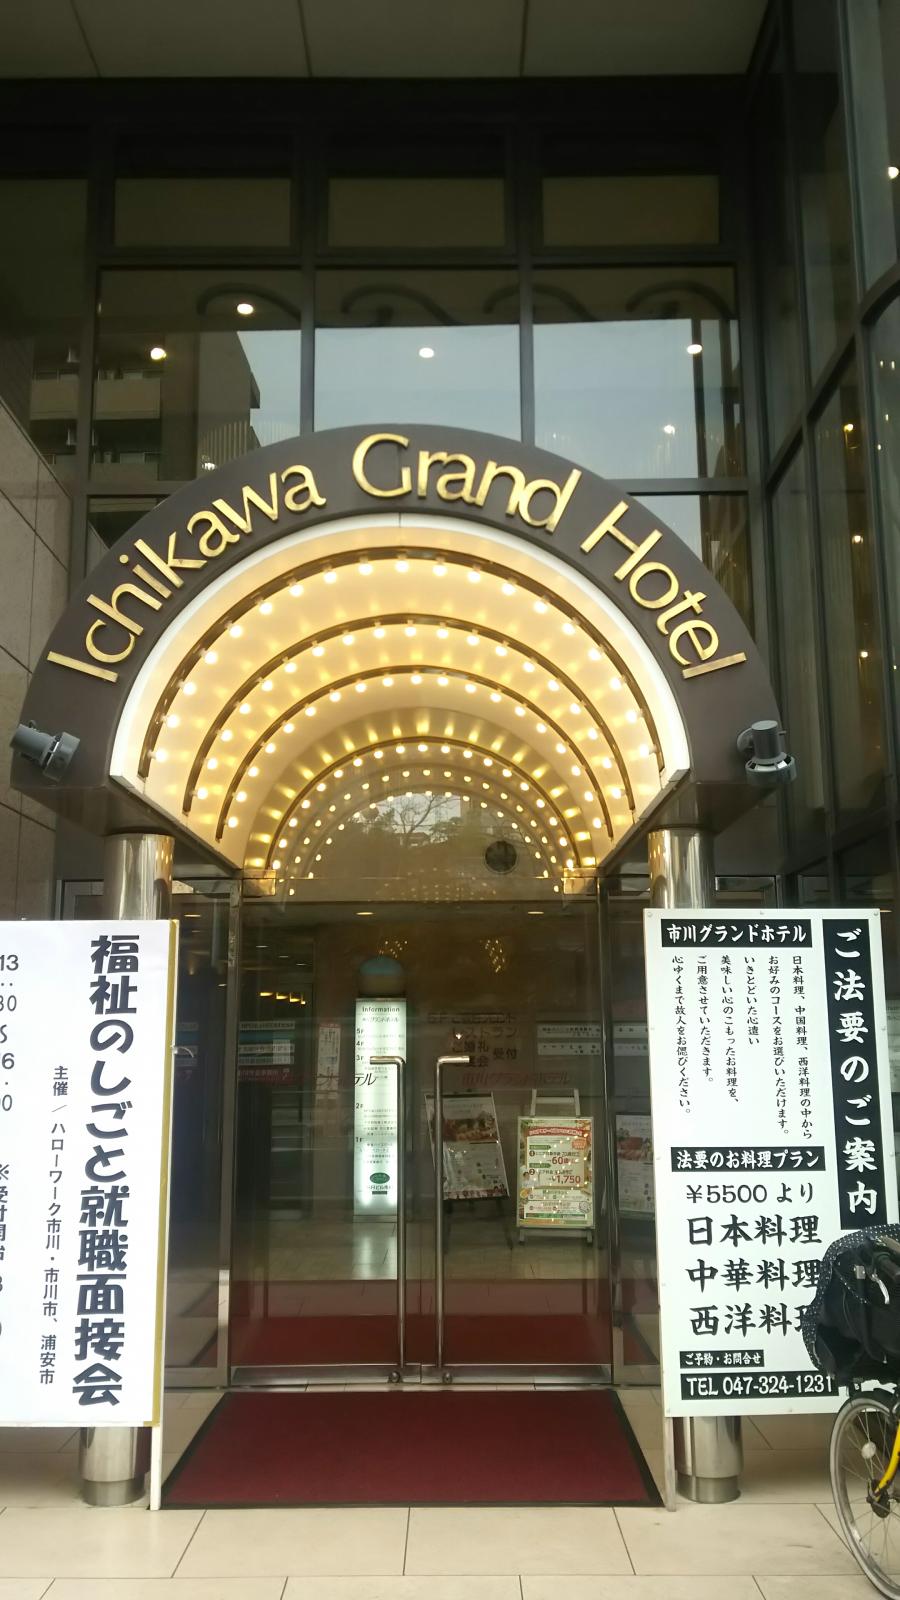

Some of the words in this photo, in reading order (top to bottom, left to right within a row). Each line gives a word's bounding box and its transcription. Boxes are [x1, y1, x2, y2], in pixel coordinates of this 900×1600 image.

[47, 464, 327, 684] Ichikawa
[352, 433, 582, 534] Grand
[580, 501, 748, 680] Hotel
[666, 923, 807, 944] 市川グランドホテル
[696, 955, 714, 1082] ご用意させていただきます。
[832, 928, 878, 1216] ご法要のご案内
[72, 934, 140, 1406] 福祉のしごと就職面接会
[676, 1150, 819, 1169] 法要のお料理プラン
[687, 1214, 823, 1248] 日本料理
[685, 1258, 823, 1293] 中華料理
[689, 1302, 803, 1337] 西洋料
[685, 1352, 761, 1365] ご予約・お問合せ
[686, 1377, 719, 1396] TEL
[722, 1375, 832, 1396] 047-324-1231
